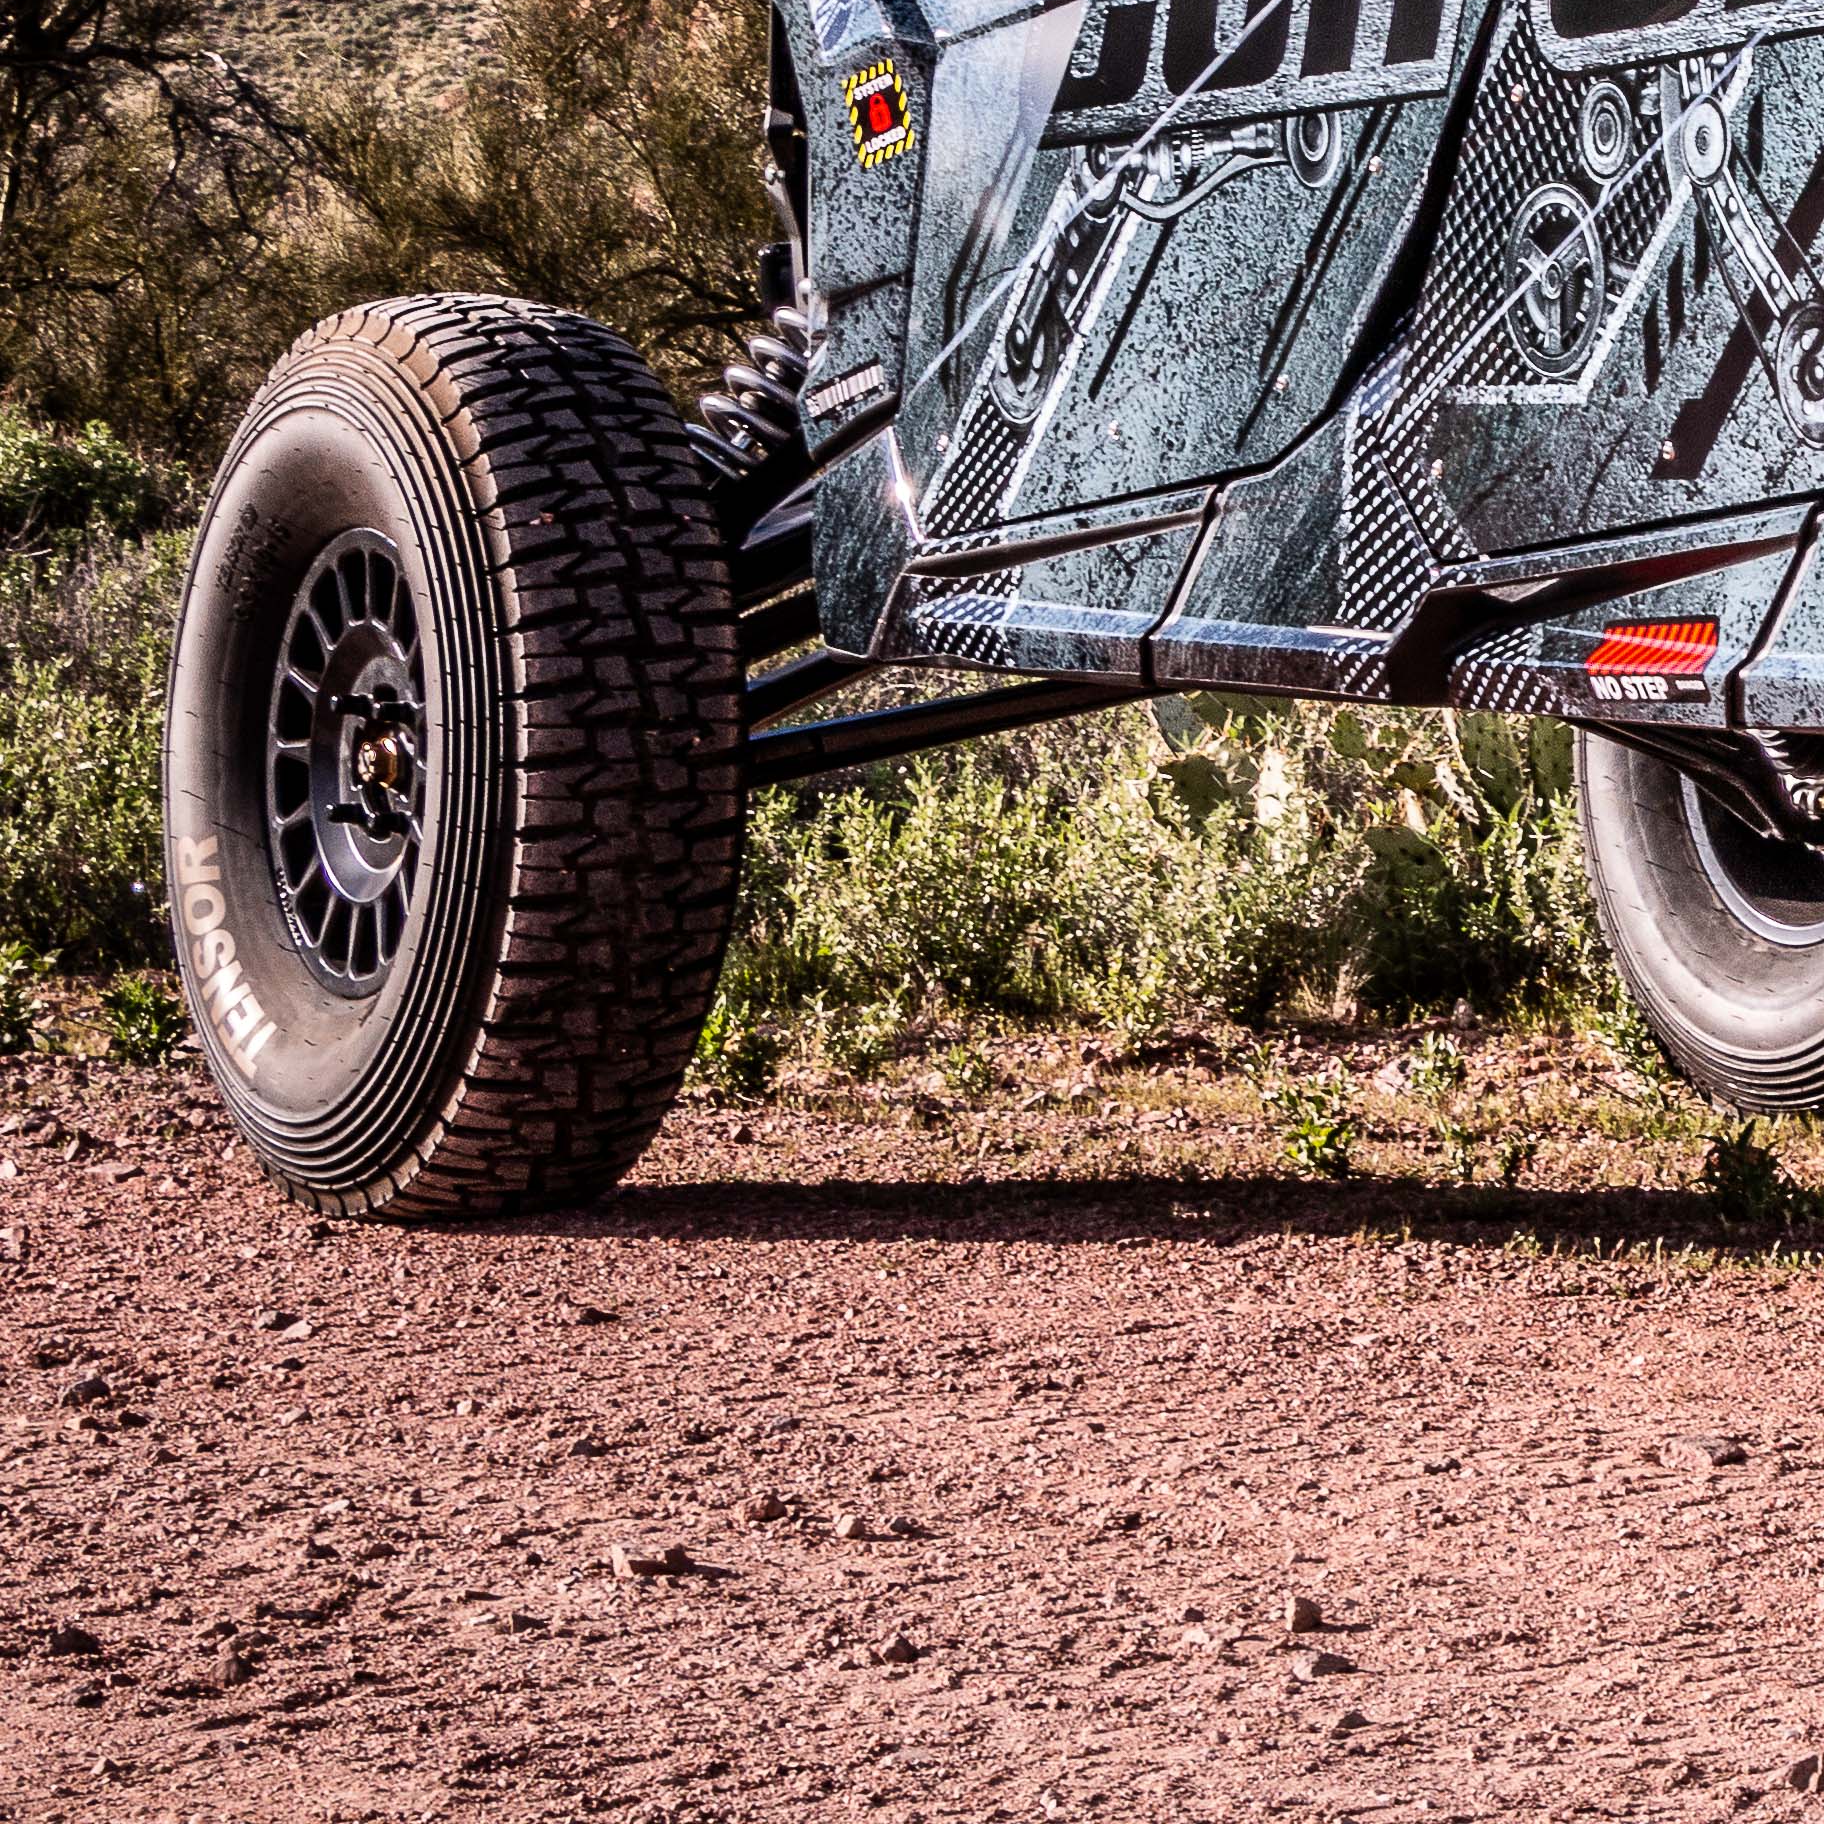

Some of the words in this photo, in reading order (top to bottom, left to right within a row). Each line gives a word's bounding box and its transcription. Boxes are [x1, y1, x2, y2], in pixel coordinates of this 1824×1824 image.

[852, 72, 895, 102] SYSTEM
[864, 125, 907, 154] LOCKED
[1590, 676, 1624, 701] NO
[1623, 675, 1669, 701] STEP
[176, 833, 279, 1081] TENSOR
